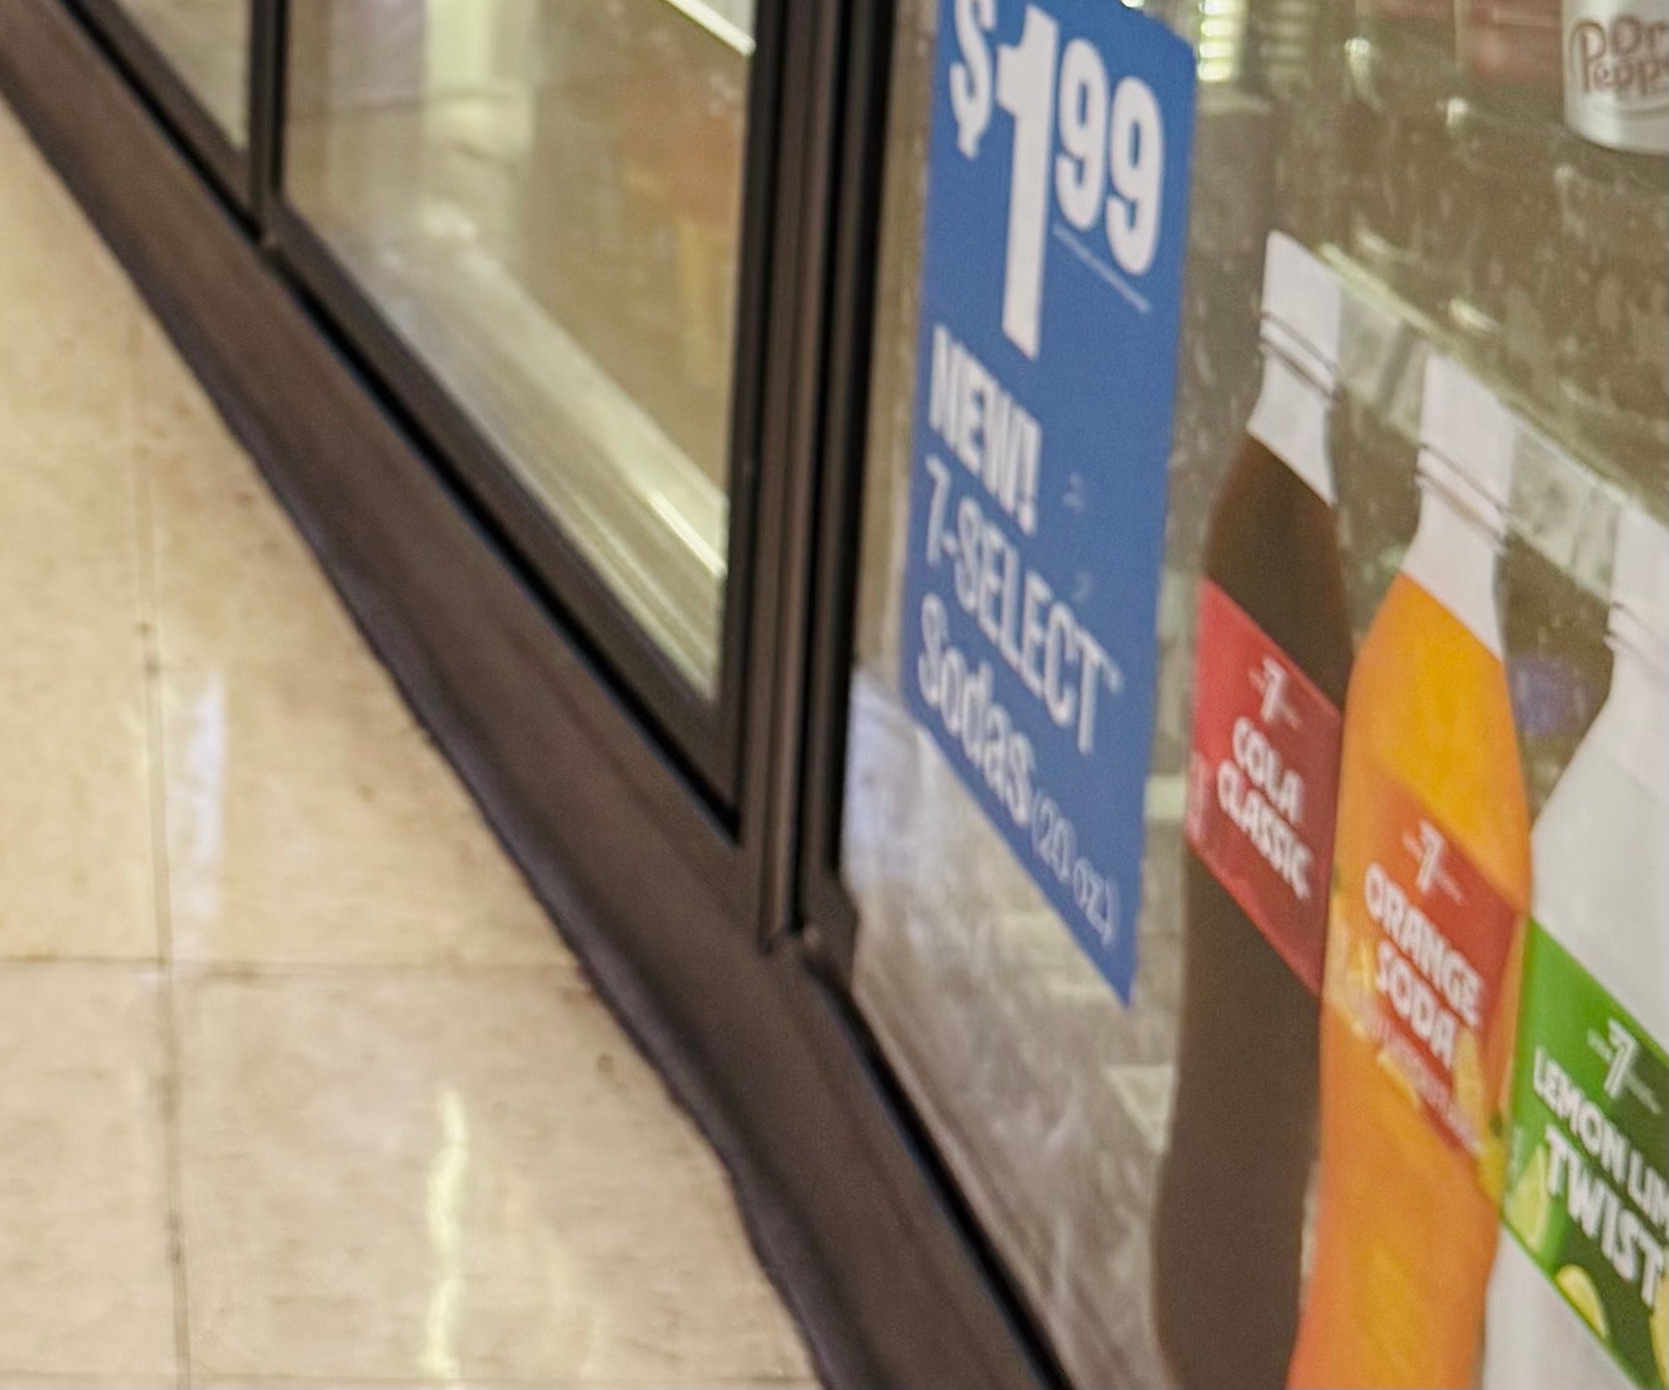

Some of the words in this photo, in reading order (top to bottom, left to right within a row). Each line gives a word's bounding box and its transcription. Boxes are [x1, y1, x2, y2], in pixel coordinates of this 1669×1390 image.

[1570, 20, 1669, 99] Pepp
[925, 454, 1123, 753] 7-SELECT
[918, 593, 1034, 827] Sodas
[1233, 717, 1303, 825] COLA
[1217, 759, 1314, 901] CLASSIC
[1364, 861, 1484, 1027] ORANGE
[1376, 940, 1457, 1070] SODA
[1533, 1044, 1629, 1186] LEMON
[1544, 1124, 1665, 1308] TWIST
